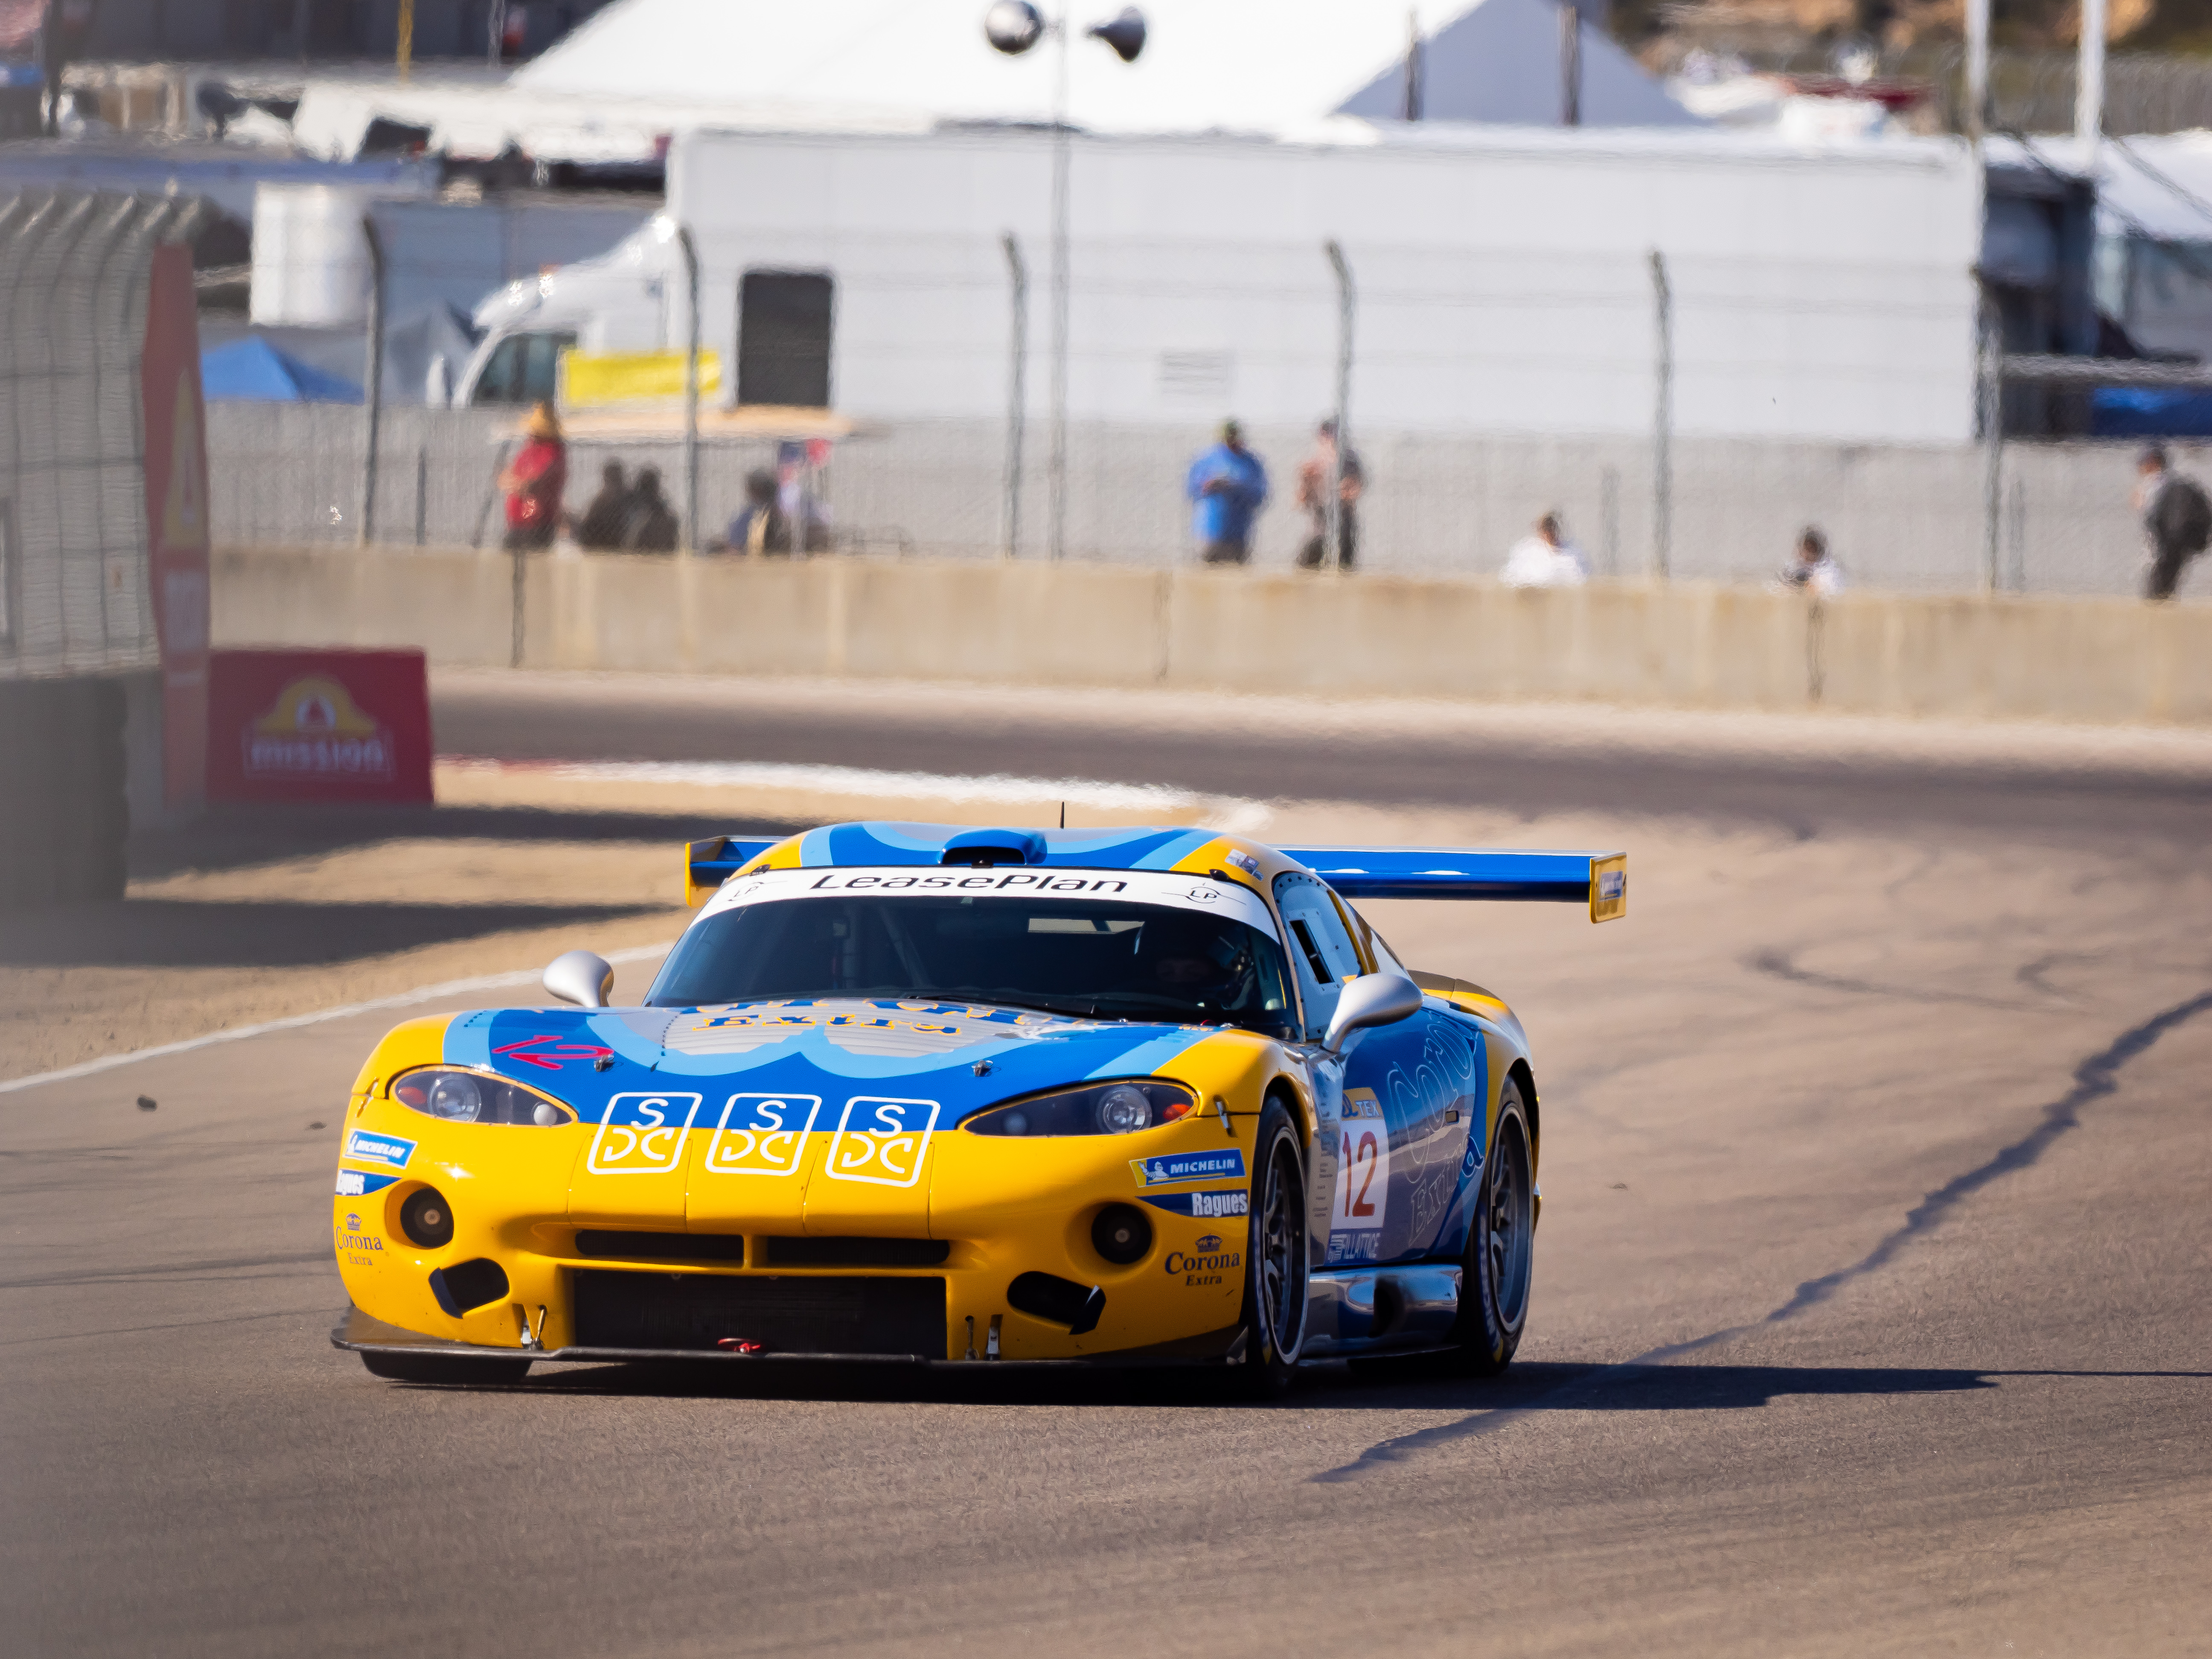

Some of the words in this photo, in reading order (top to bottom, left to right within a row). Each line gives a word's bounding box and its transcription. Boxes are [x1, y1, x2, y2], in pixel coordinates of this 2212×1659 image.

[809, 874, 1128, 893] LeasePlan
[1189, 890, 1217, 899] LP
[355, 1139, 405, 1158] MICHELIN
[1170, 1158, 1236, 1174] MICHELIN
[1342, 1131, 1377, 1217] 12
[1192, 1192, 1248, 1217] Ragues
[336, 1225, 384, 1251] Corona
[347, 1252, 373, 1266] Extra
[1164, 1251, 1240, 1275] Corona
[1185, 1274, 1222, 1286] Extra
